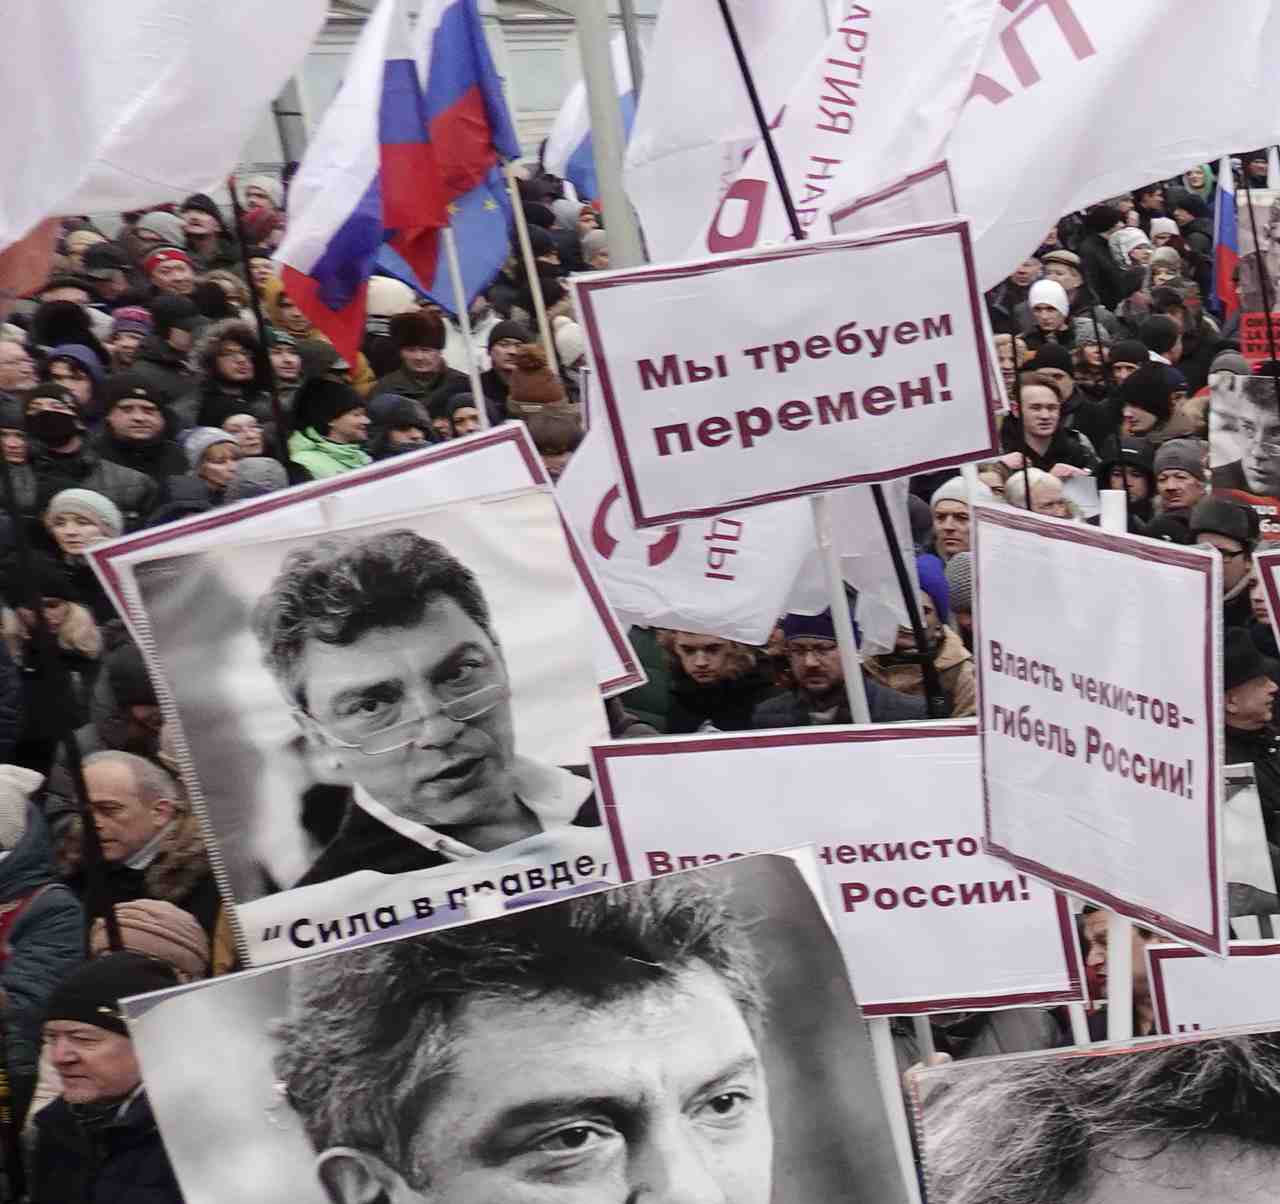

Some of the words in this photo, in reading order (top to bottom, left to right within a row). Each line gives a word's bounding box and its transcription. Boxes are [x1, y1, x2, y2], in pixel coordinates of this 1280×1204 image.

[638, 350, 729, 391] Мы
[744, 313, 954, 369] требуем
[654, 362, 955, 456] перемен!
[990, 639, 1064, 692] Власть
[992, 703, 1077, 758] гибель
[1085, 725, 1194, 800] России!
[819, 836, 983, 865] чекисто
[262, 905, 402, 950] “Сила
[413, 896, 435, 920] в
[447, 854, 610, 911] павде,
[840, 874, 1031, 913] России!
